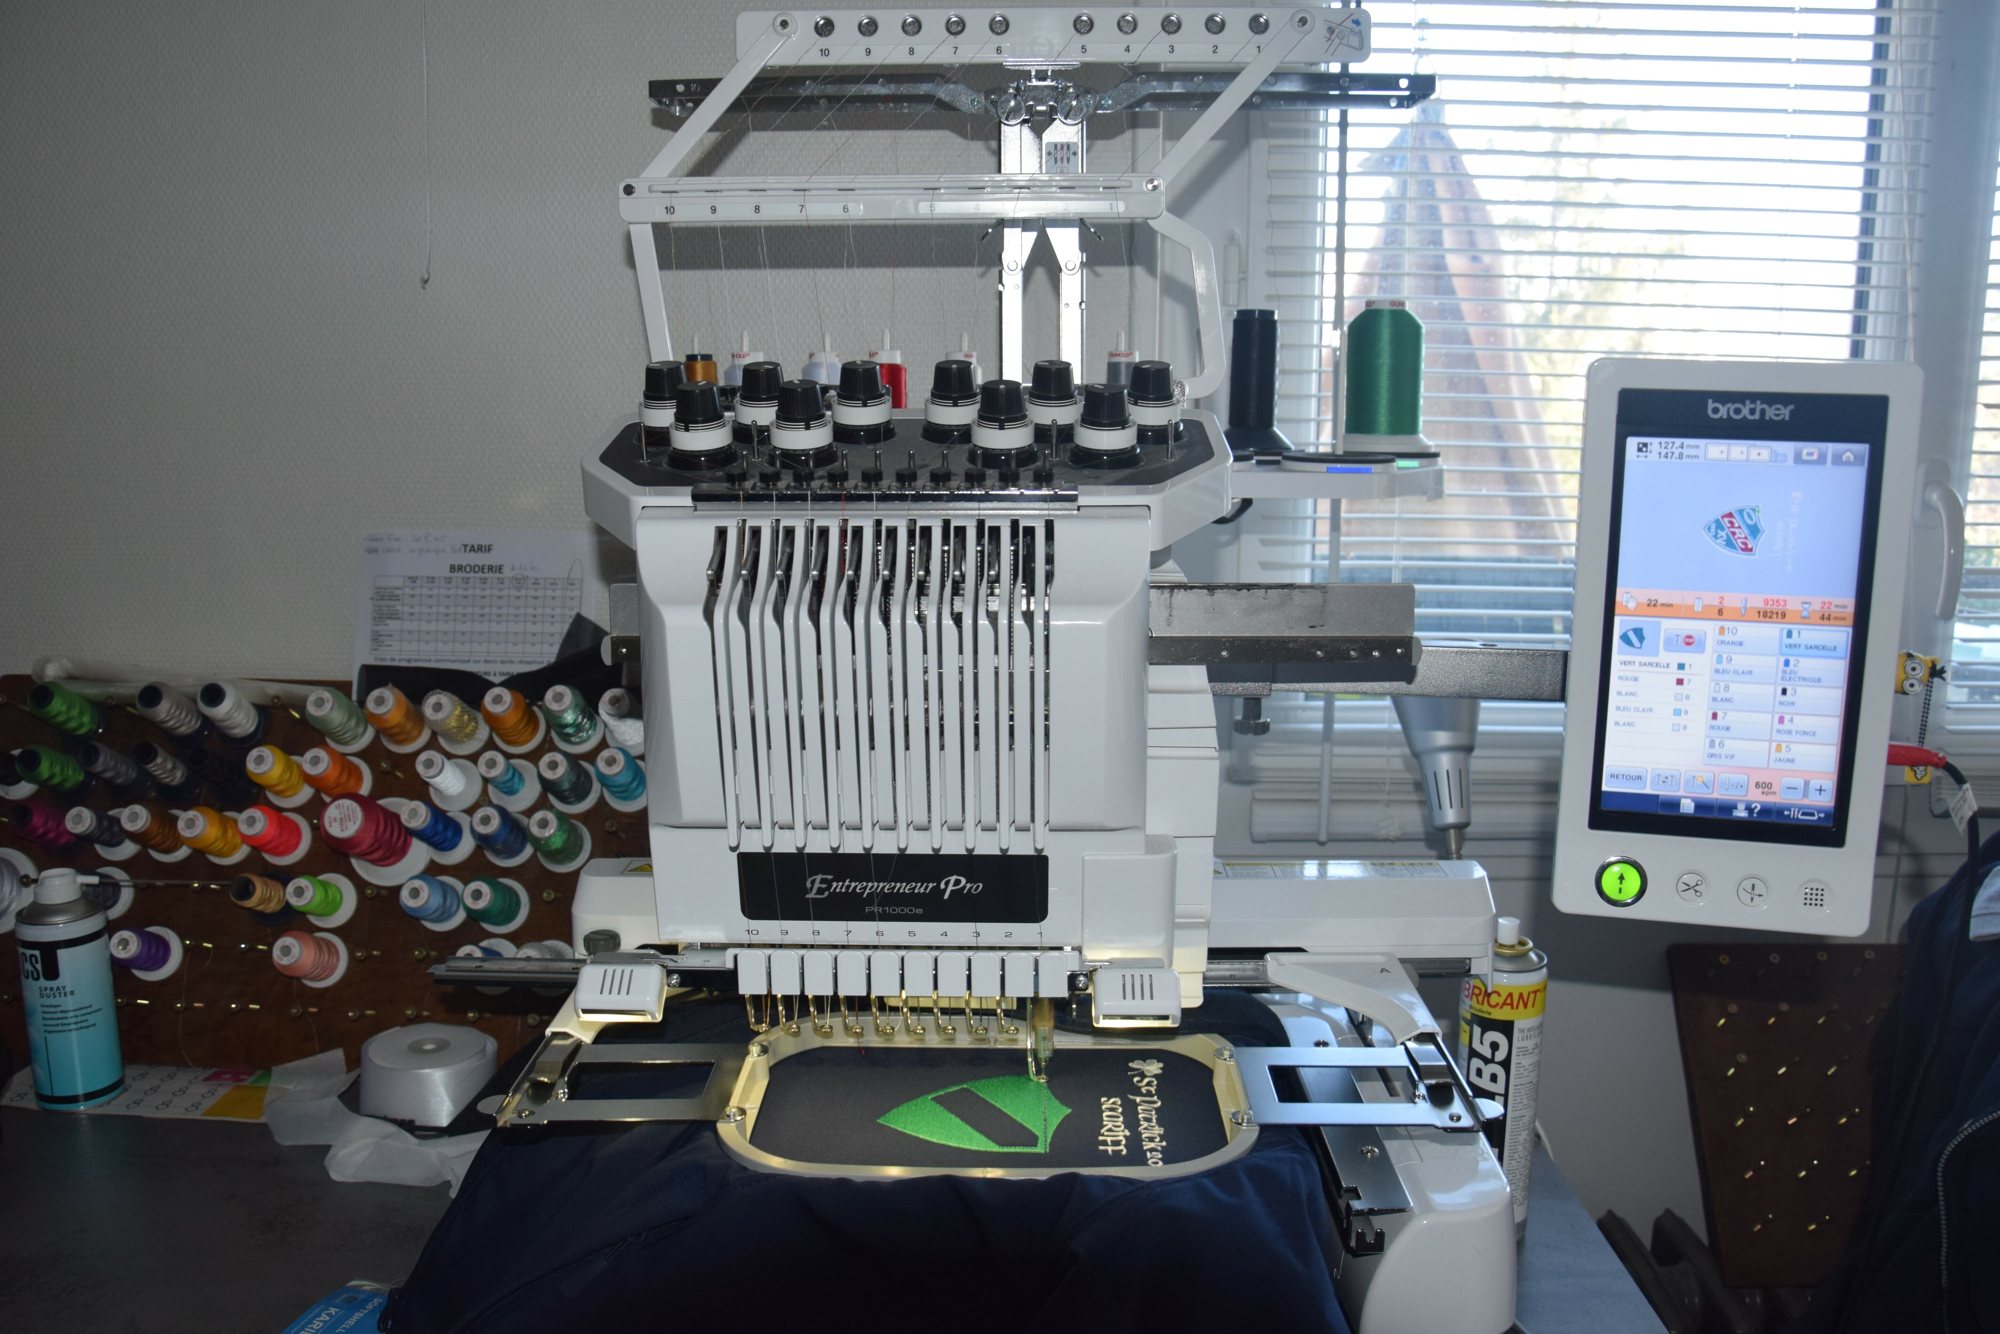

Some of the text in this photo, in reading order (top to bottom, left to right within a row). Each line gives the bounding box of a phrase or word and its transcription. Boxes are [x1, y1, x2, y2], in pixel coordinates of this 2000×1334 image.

[819, 45, 1261, 57] 10 9 8 7 6 5 4 3 2 1
[665, 206, 675, 215] 10
[711, 205, 716, 214] 9
[754, 205, 760, 214] 8
[799, 205, 805, 213] 7
[842, 205, 849, 213] 6
[1110, 203, 1113, 211] 1
[1707, 400, 1794, 421] brother
[1658, 441, 1684, 450] 127.4
[1658, 451, 1684, 460] 147.8
[1724, 518, 1752, 549] CRC
[462, 543, 494, 554] TARIF
[449, 564, 504, 574] BRODERIE
[1646, 599, 1674, 609] 22 min
[1718, 596, 1725, 605] 2
[1763, 598, 1787, 608] 9353
[1820, 601, 1832, 610] 22
[1717, 608, 1724, 617] 6
[1756, 610, 1786, 620] 18219
[1819, 613, 1831, 622] 44
[1726, 627, 1737, 636] 10
[1797, 630, 1801, 639] 1
[1717, 639, 1744, 647] ORANGE
[1804, 644, 1838, 652] SARCELLE
[1726, 655, 1732, 664] 9
[1793, 659, 1800, 667] 2
[1639, 661, 1670, 669] SARCELLE
[1714, 667, 1753, 677] BLEU CLAIR
[1723, 684, 1730, 693] 8
[1790, 687, 1797, 696] 3
[1711, 696, 1734, 704] BLANC
[1779, 700, 1795, 708] NOIR
[1721, 712, 1727, 720] 7
[1788, 716, 1794, 724] 4
[1709, 724, 1731, 732] ROUGE
[1776, 728, 1794, 736] ROSE
[1718, 740, 1725, 749] 6
[1785, 745, 1791, 753] 5
[1707, 752, 1722, 760] GRIS
[1774, 756, 1796, 765] JAUNE
[1610, 773, 1642, 782] RETOUR
[1755, 781, 1773, 790] 600
[805, 874, 983, 899] Entrepreneur Pro
[865, 906, 924, 914] PR1000e
[38, 985, 67, 993] SPRAY
[39, 990, 75, 999] DUSTER
[1133, 1076, 1158, 1094] St
